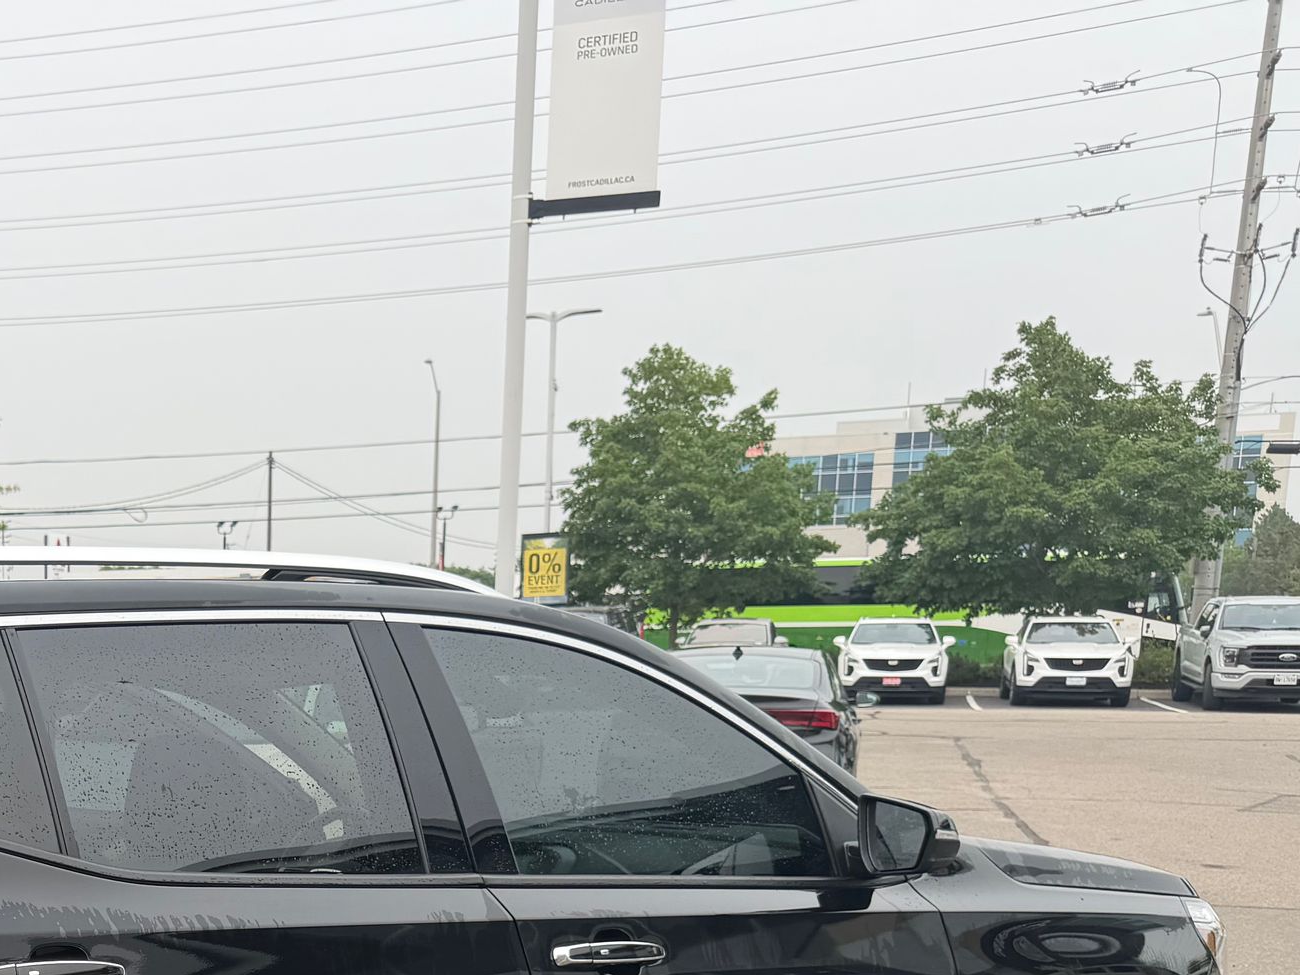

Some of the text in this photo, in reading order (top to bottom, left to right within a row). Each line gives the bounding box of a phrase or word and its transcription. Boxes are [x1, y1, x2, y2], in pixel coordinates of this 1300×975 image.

[578, 31, 638, 49] CERTIFIED
[577, 44, 638, 60] PRE-OWNED
[529, 552, 561, 575] 0%
[528, 575, 561, 586] EVENT
